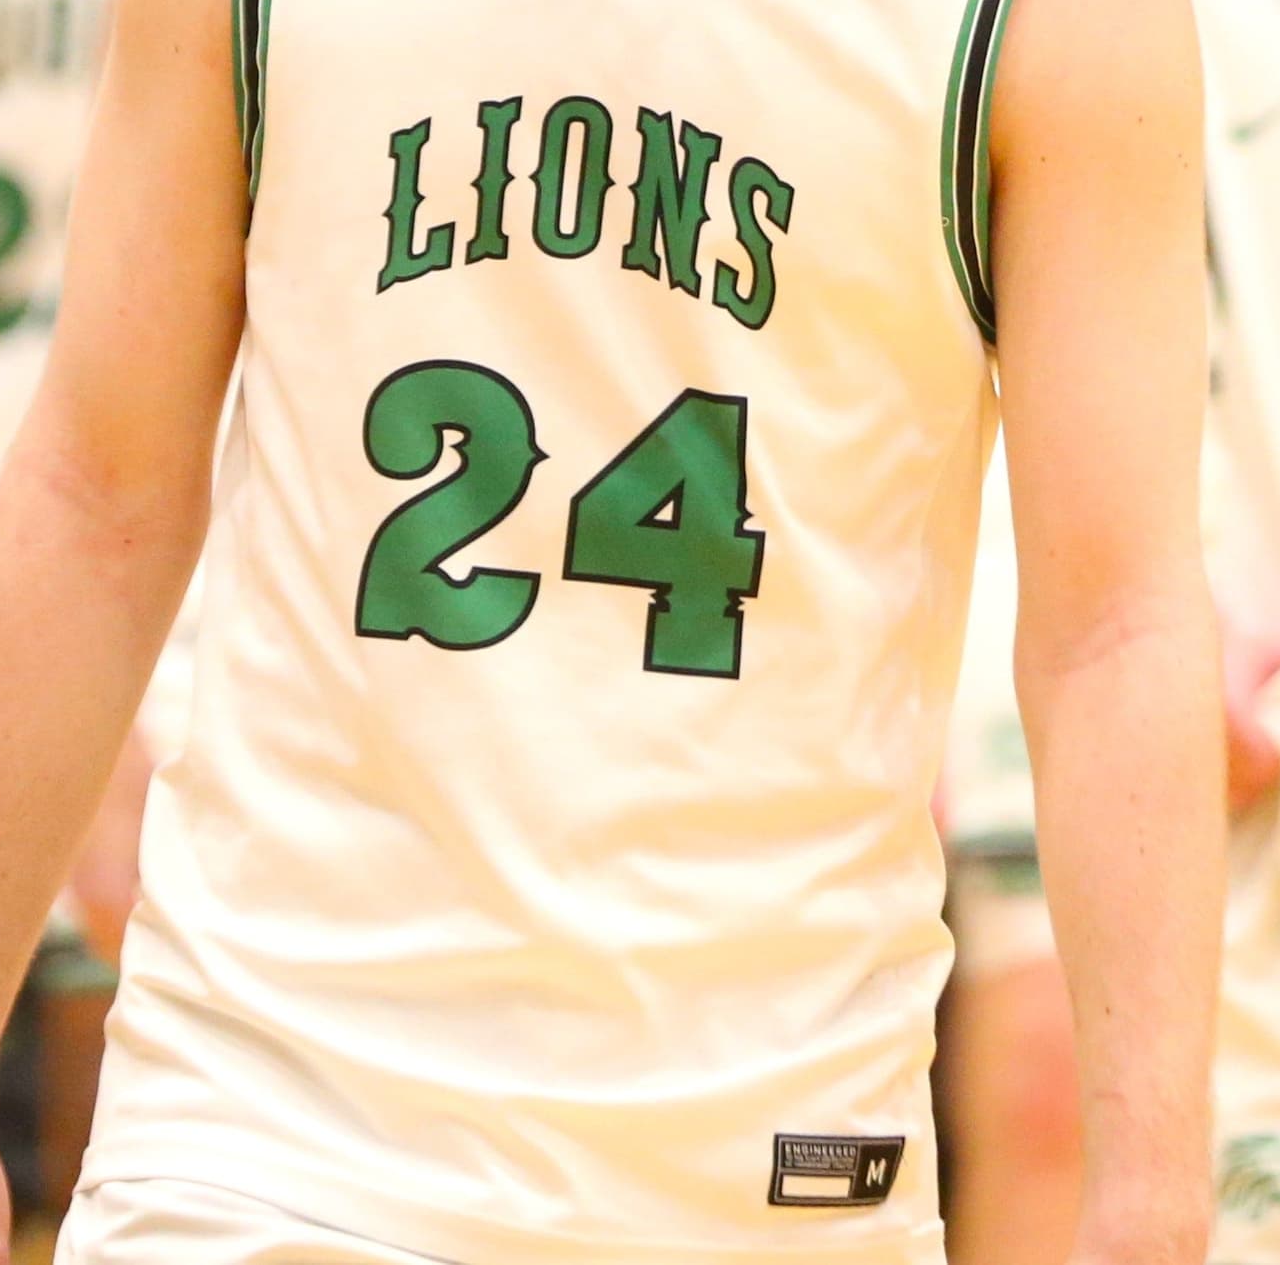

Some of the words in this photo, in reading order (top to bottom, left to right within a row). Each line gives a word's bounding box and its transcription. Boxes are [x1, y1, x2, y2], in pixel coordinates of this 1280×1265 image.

[377, 96, 794, 330] LIONS
[355, 359, 766, 680] 24
[866, 1158, 887, 1187] M
